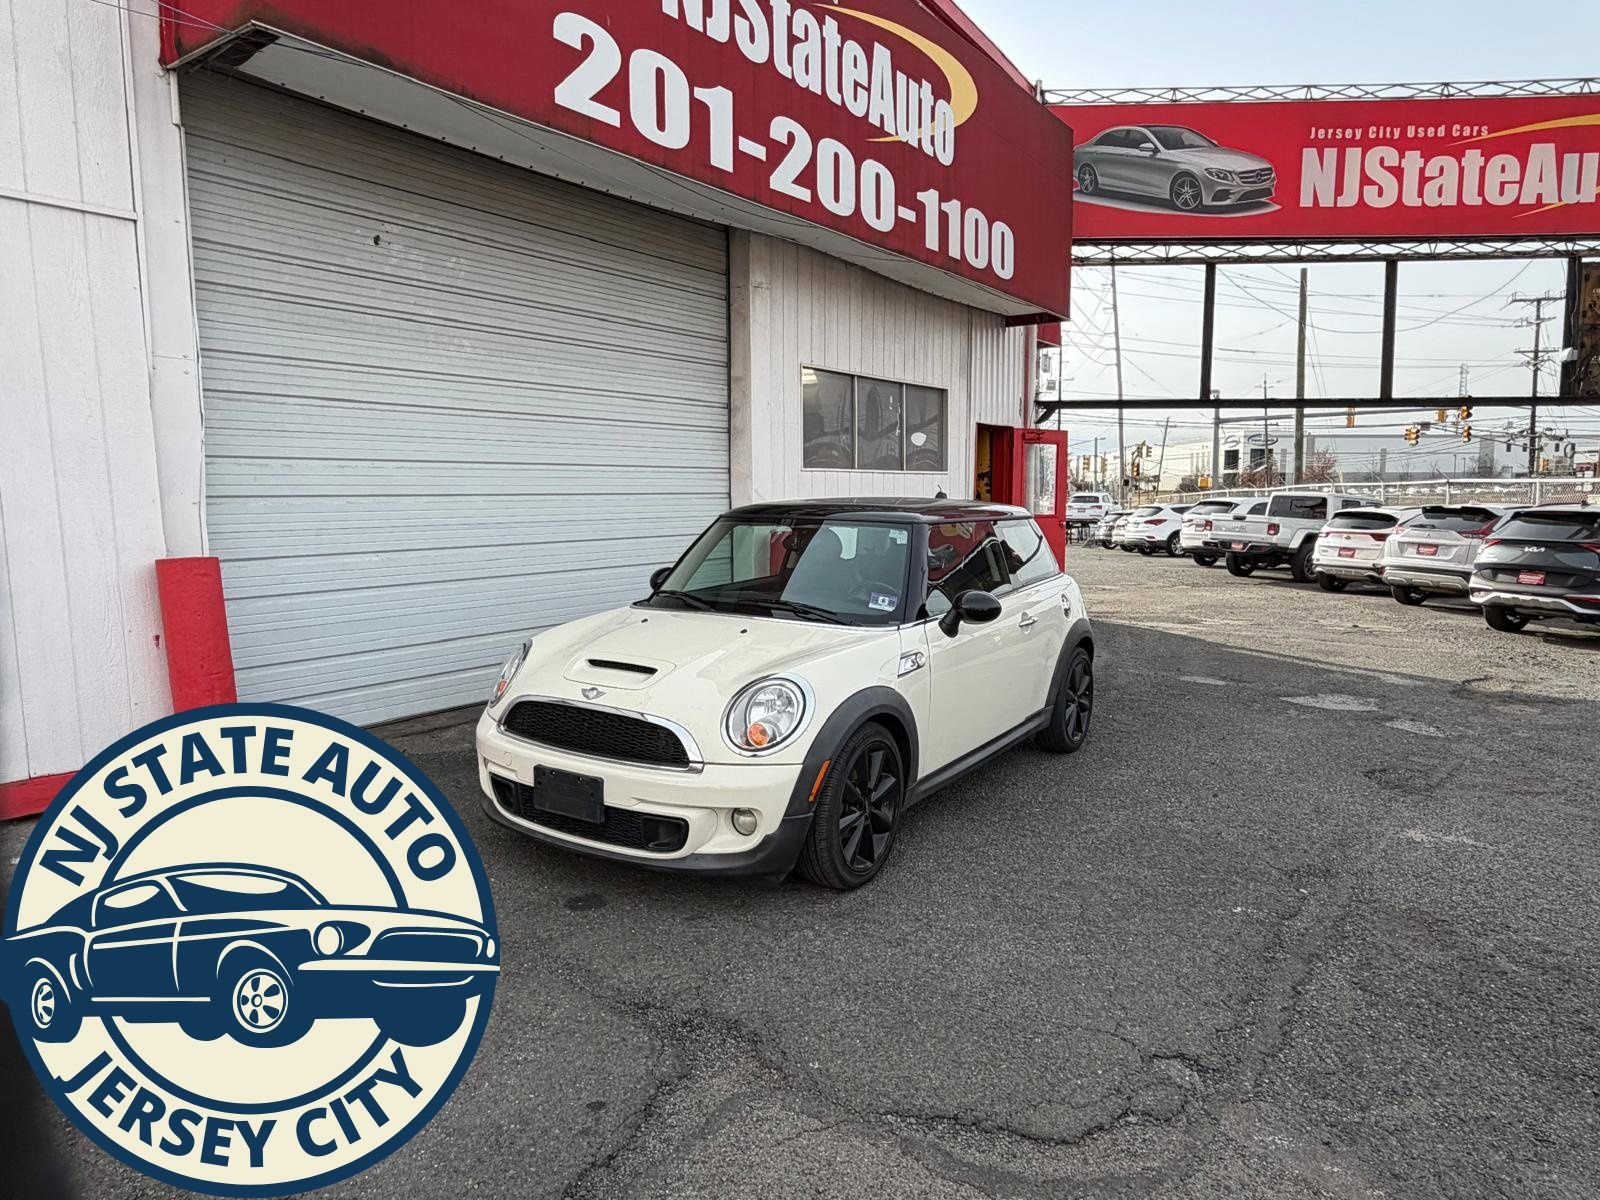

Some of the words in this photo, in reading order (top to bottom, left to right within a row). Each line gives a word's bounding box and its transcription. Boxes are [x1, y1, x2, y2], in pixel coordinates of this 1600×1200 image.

[662, 0, 955, 167] StateAuto
[1310, 126, 1363, 140] Jersey
[1368, 125, 1401, 139] City
[1406, 125, 1446, 138] Used
[1452, 123, 1489, 137] Cars
[552, 12, 1015, 281] 201-200-1100
[1299, 143, 1600, 208] NJStateAu
